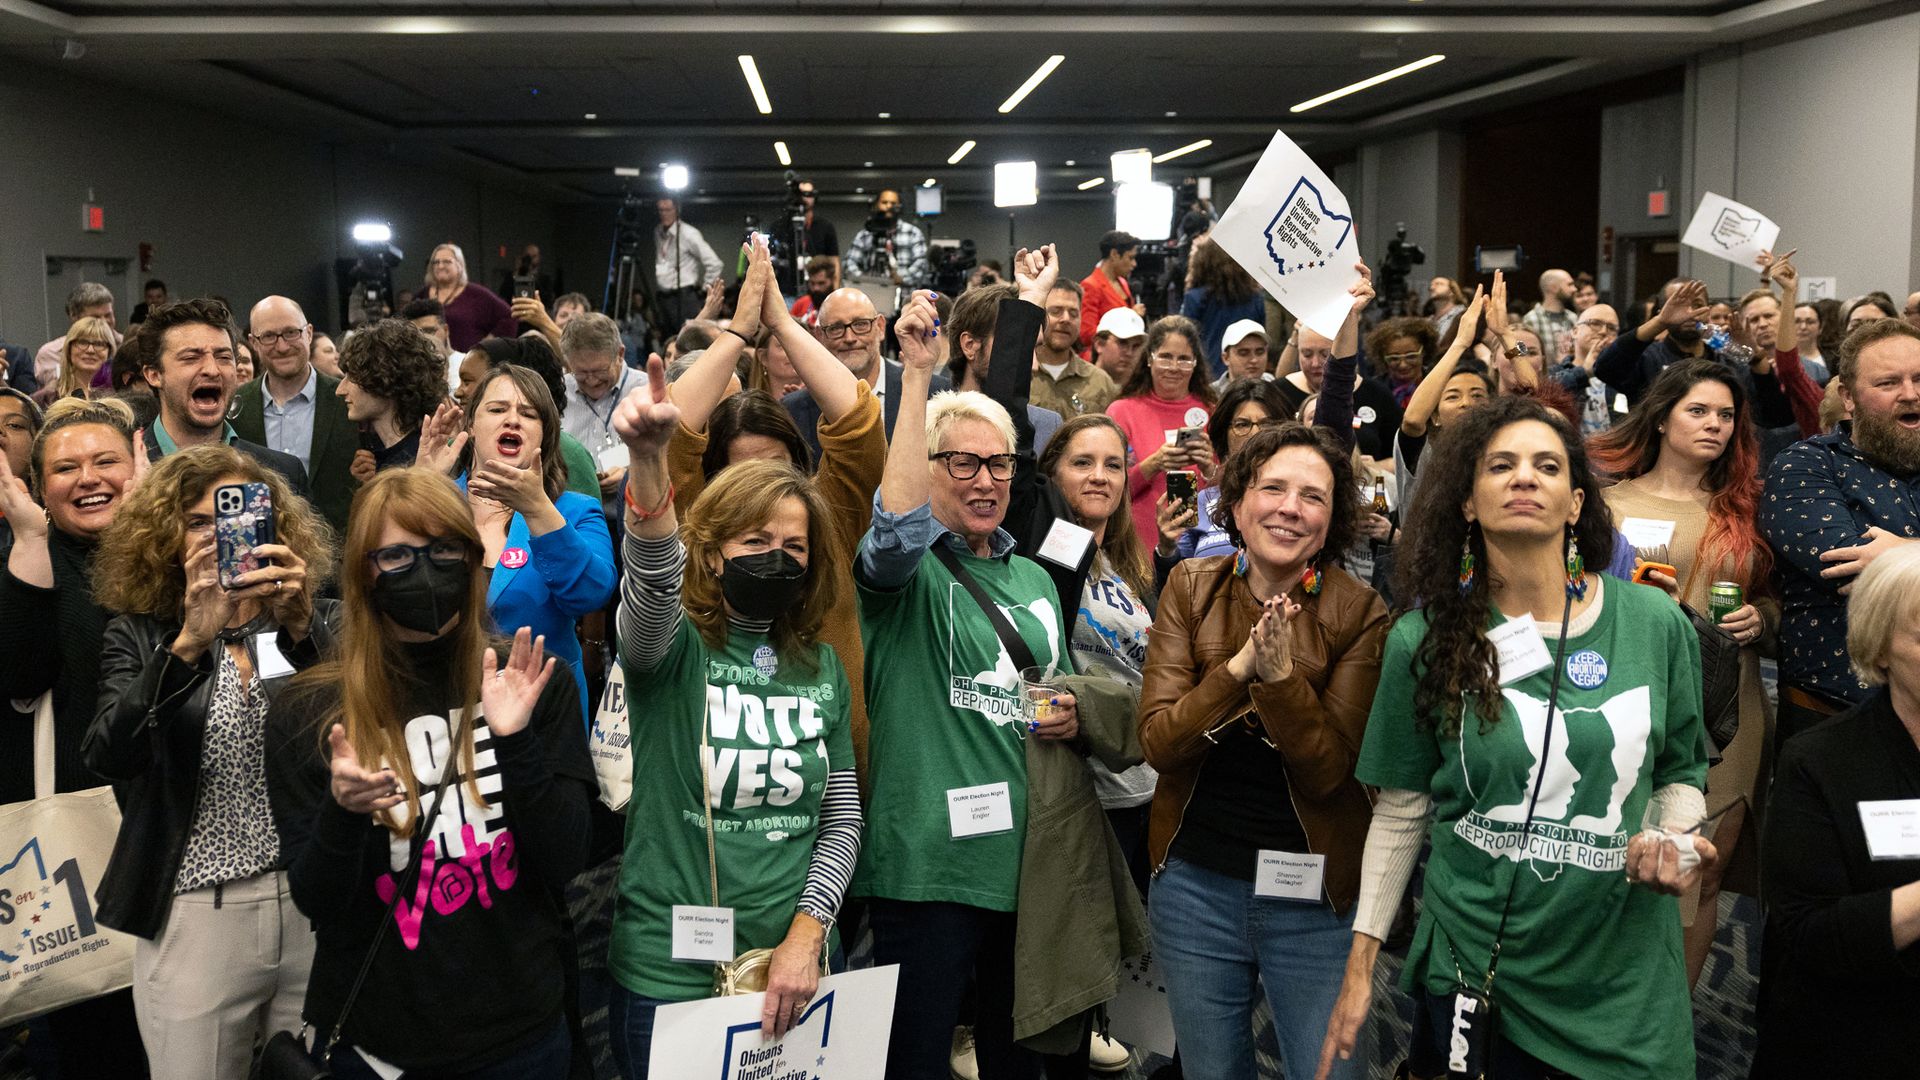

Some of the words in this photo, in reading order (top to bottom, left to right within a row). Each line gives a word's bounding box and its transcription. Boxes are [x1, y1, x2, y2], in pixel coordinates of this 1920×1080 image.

[1290, 206, 1312, 230] United
[1296, 197, 1320, 225] Ohioans
[1277, 225, 1298, 249] Rights
[1283, 216, 1322, 257] Reproductive
[1086, 573, 1134, 615] YES
[1570, 663, 1606, 677] ABORTION
[1575, 652, 1599, 664] KEEP
[1574, 674, 1603, 686] LEGAL
[707, 684, 823, 747] VOTE
[700, 744, 804, 809] YES
[682, 810, 742, 833] PROECT
[744, 815, 810, 833] ABORTION
[1466, 812, 1492, 830] HIO
[1505, 822, 1597, 846] PHYSICIANS
[1456, 822, 1571, 861] REPRODUCTIVE
[53, 857, 97, 938] 1
[375, 823, 518, 950] Vote
[23, 944, 80, 974] Reproductive
[81, 937, 110, 956] Rights
[29, 924, 78, 956] ISSUE
[737, 1059, 774, 1080] United
[775, 1058, 787, 1074] for
[740, 1043, 783, 1067] Ohioans
